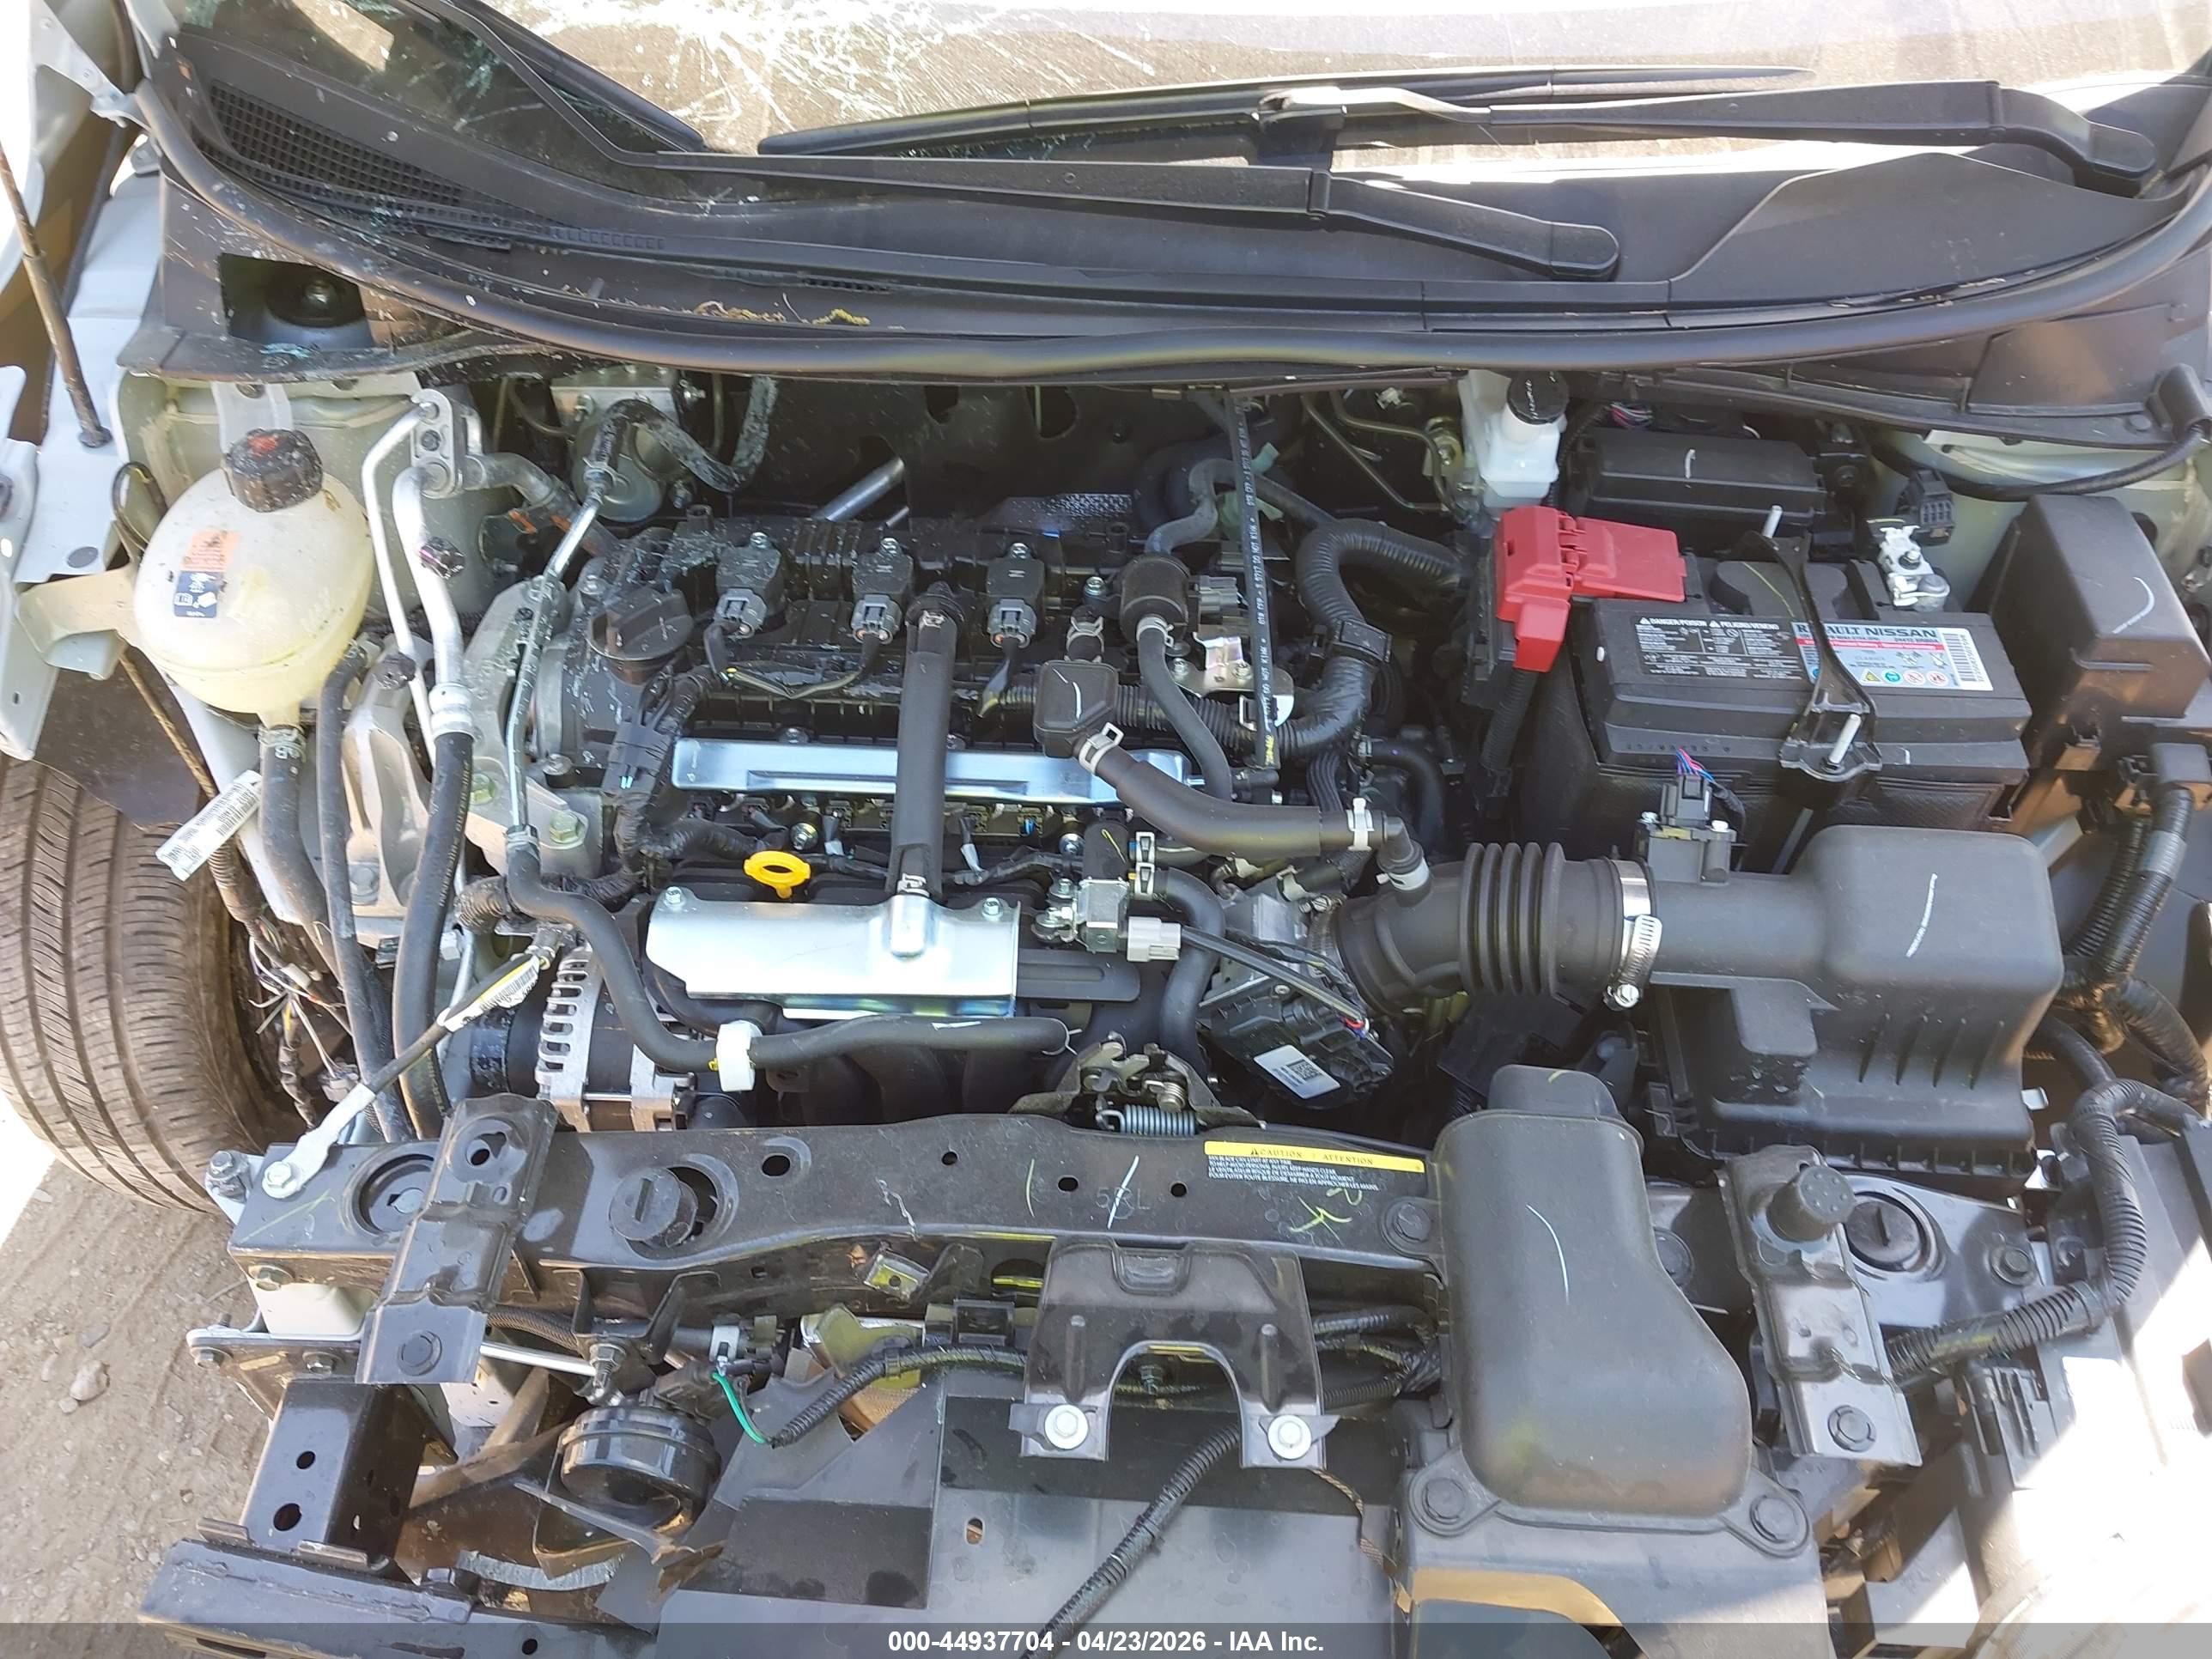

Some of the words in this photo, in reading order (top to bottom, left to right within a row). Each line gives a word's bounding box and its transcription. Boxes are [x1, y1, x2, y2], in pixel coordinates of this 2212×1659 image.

[1796, 623, 1861, 635] RAULT
[1865, 627, 1937, 638] NISSAN
[1259, 1148, 1303, 1158] CAUTION
[1322, 1154, 1374, 1165] ATTENTION
